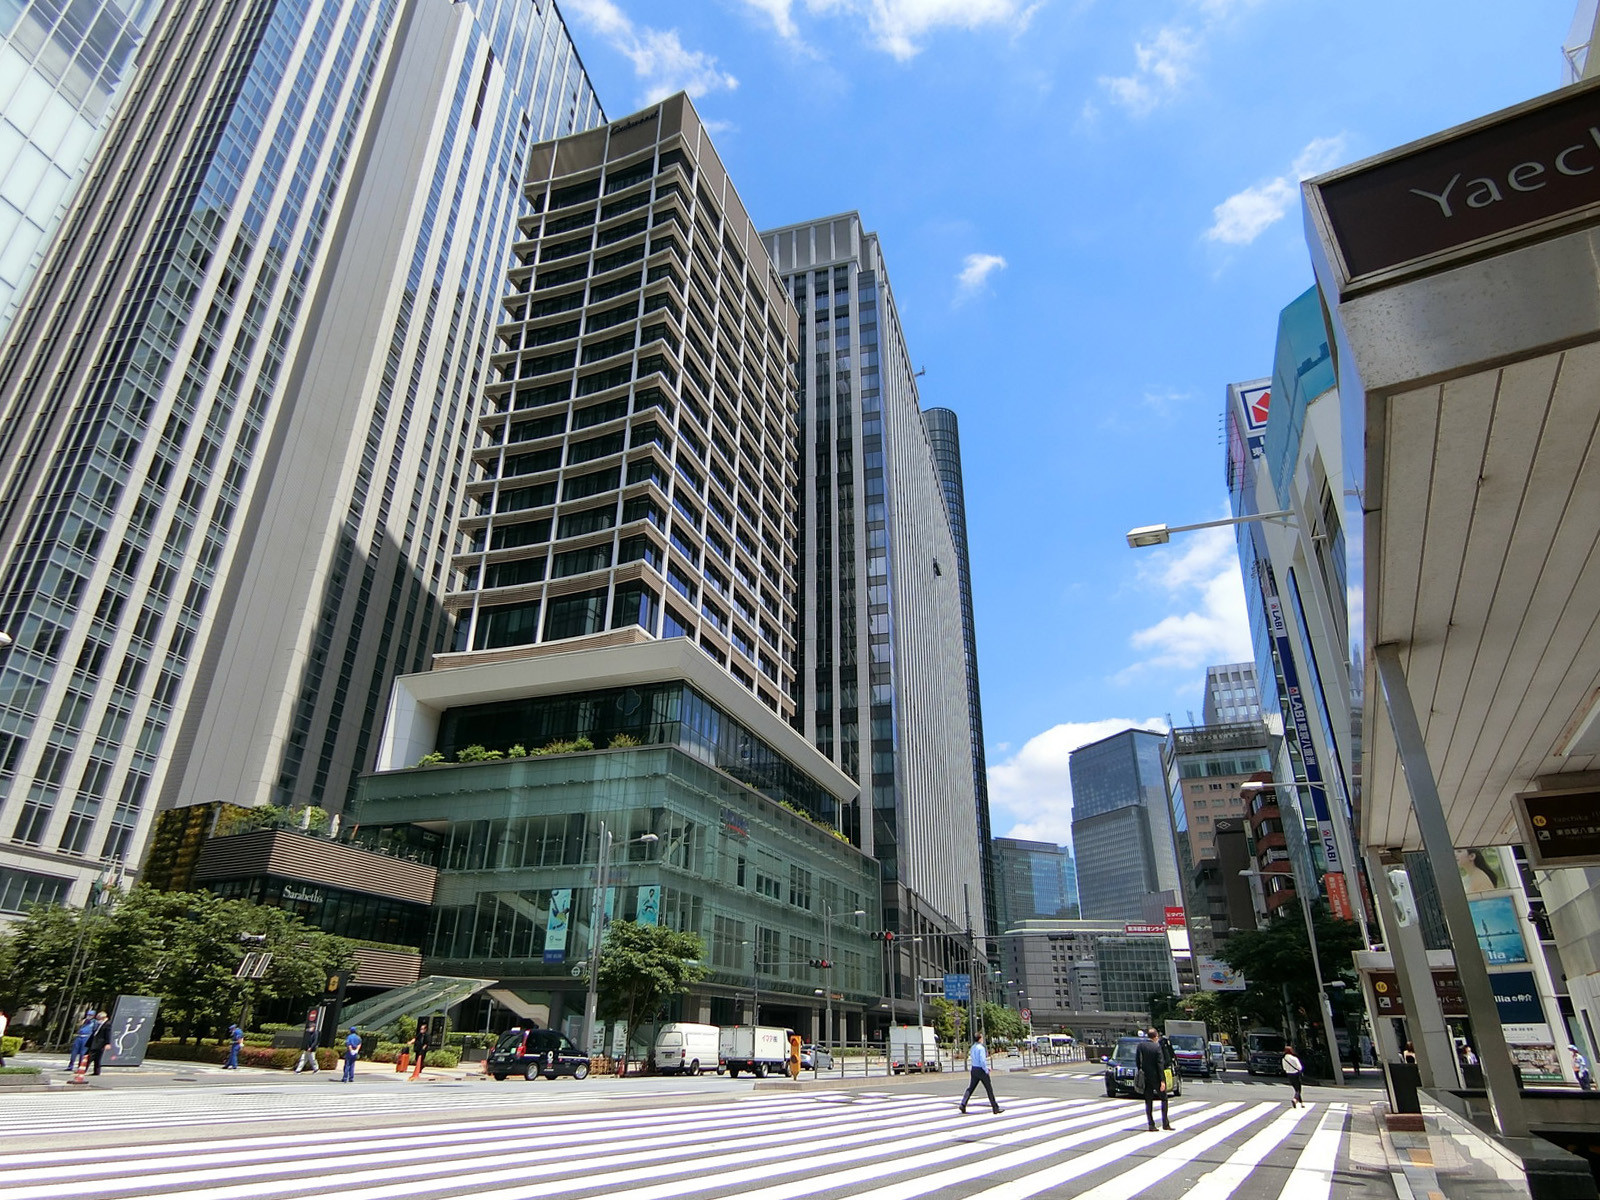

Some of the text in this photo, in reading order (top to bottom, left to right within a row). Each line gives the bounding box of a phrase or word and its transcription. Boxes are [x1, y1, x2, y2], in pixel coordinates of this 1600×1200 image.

[1271, 610, 1284, 631] LABI
[1291, 695, 1316, 766] LABI 東京八重洲
[1324, 838, 1337, 862] LABI
[282, 885, 324, 903] Sarabeth's
